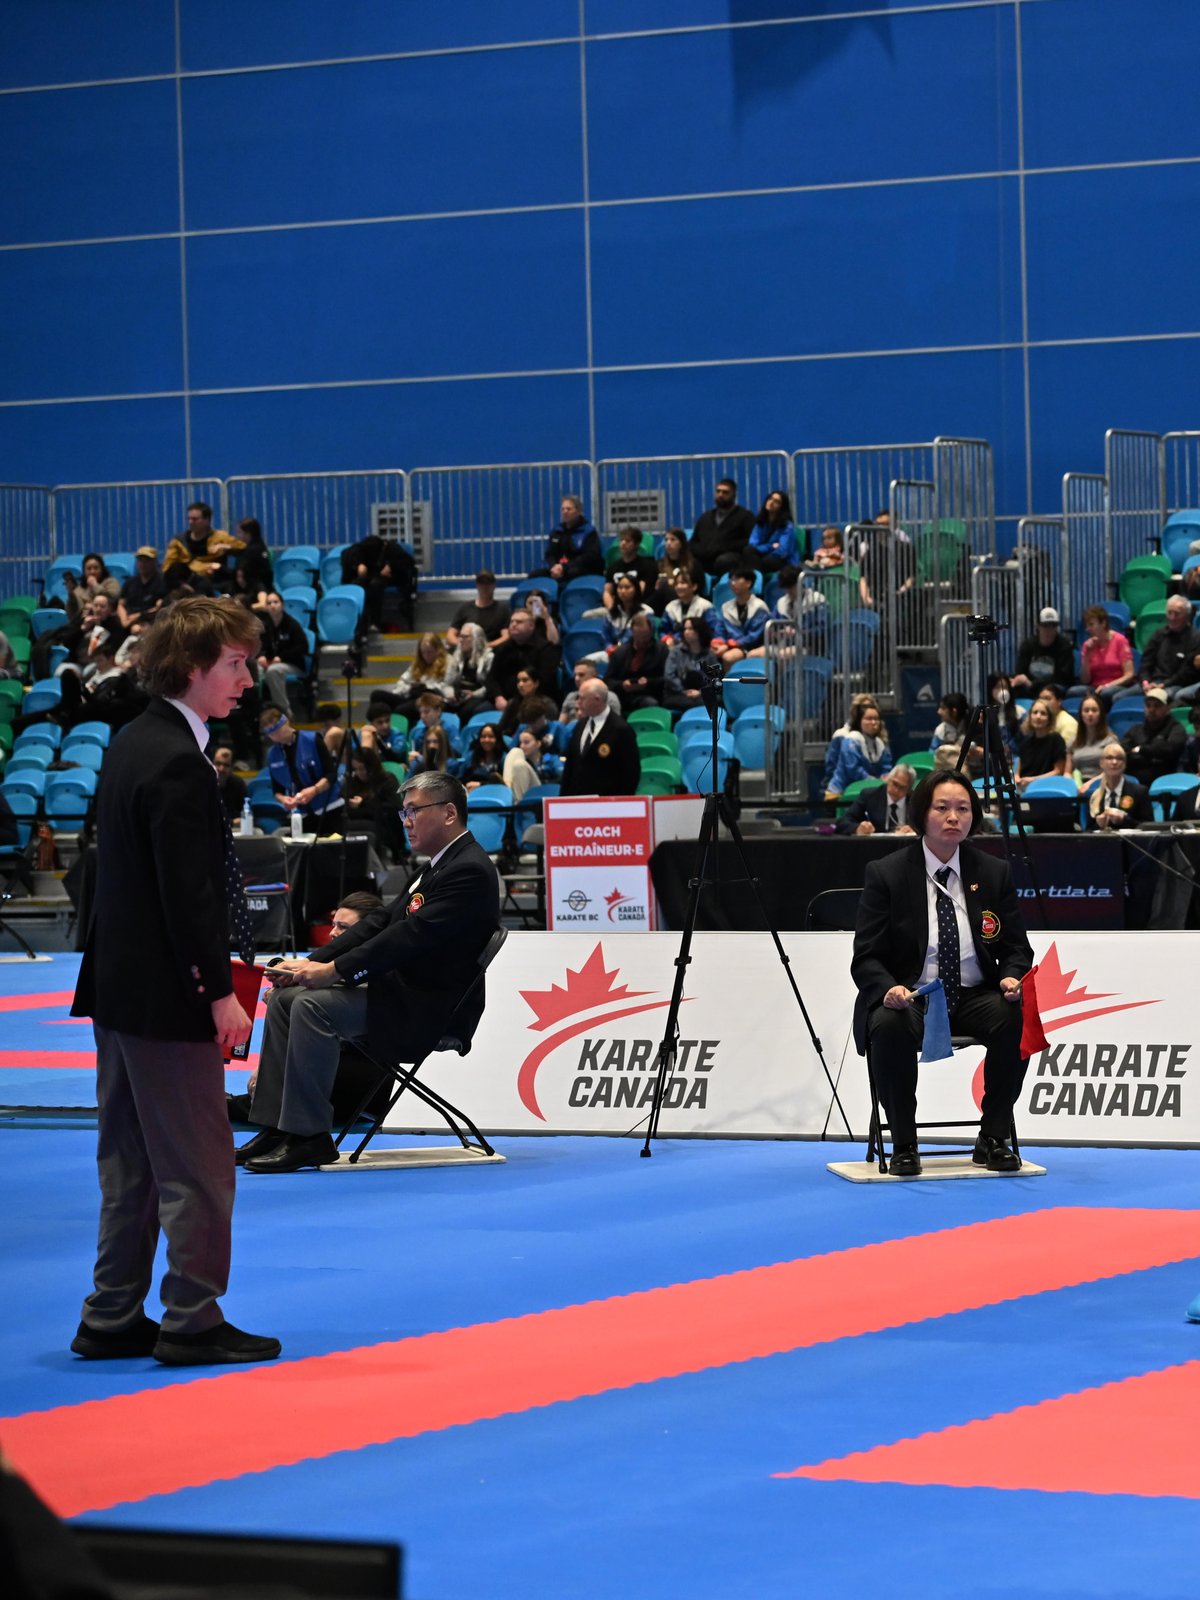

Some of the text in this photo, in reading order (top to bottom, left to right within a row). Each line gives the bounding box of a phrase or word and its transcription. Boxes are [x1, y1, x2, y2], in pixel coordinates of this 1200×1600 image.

[575, 826, 621, 838] COACH
[1016, 885, 1113, 897] ortdata
[556, 914, 587, 922] KARATE
[618, 913, 646, 921] CANADA
[1036, 1043, 1192, 1078] KARATE
[568, 1076, 708, 1109] CANADA
[1028, 1082, 1182, 1117] CANADA
